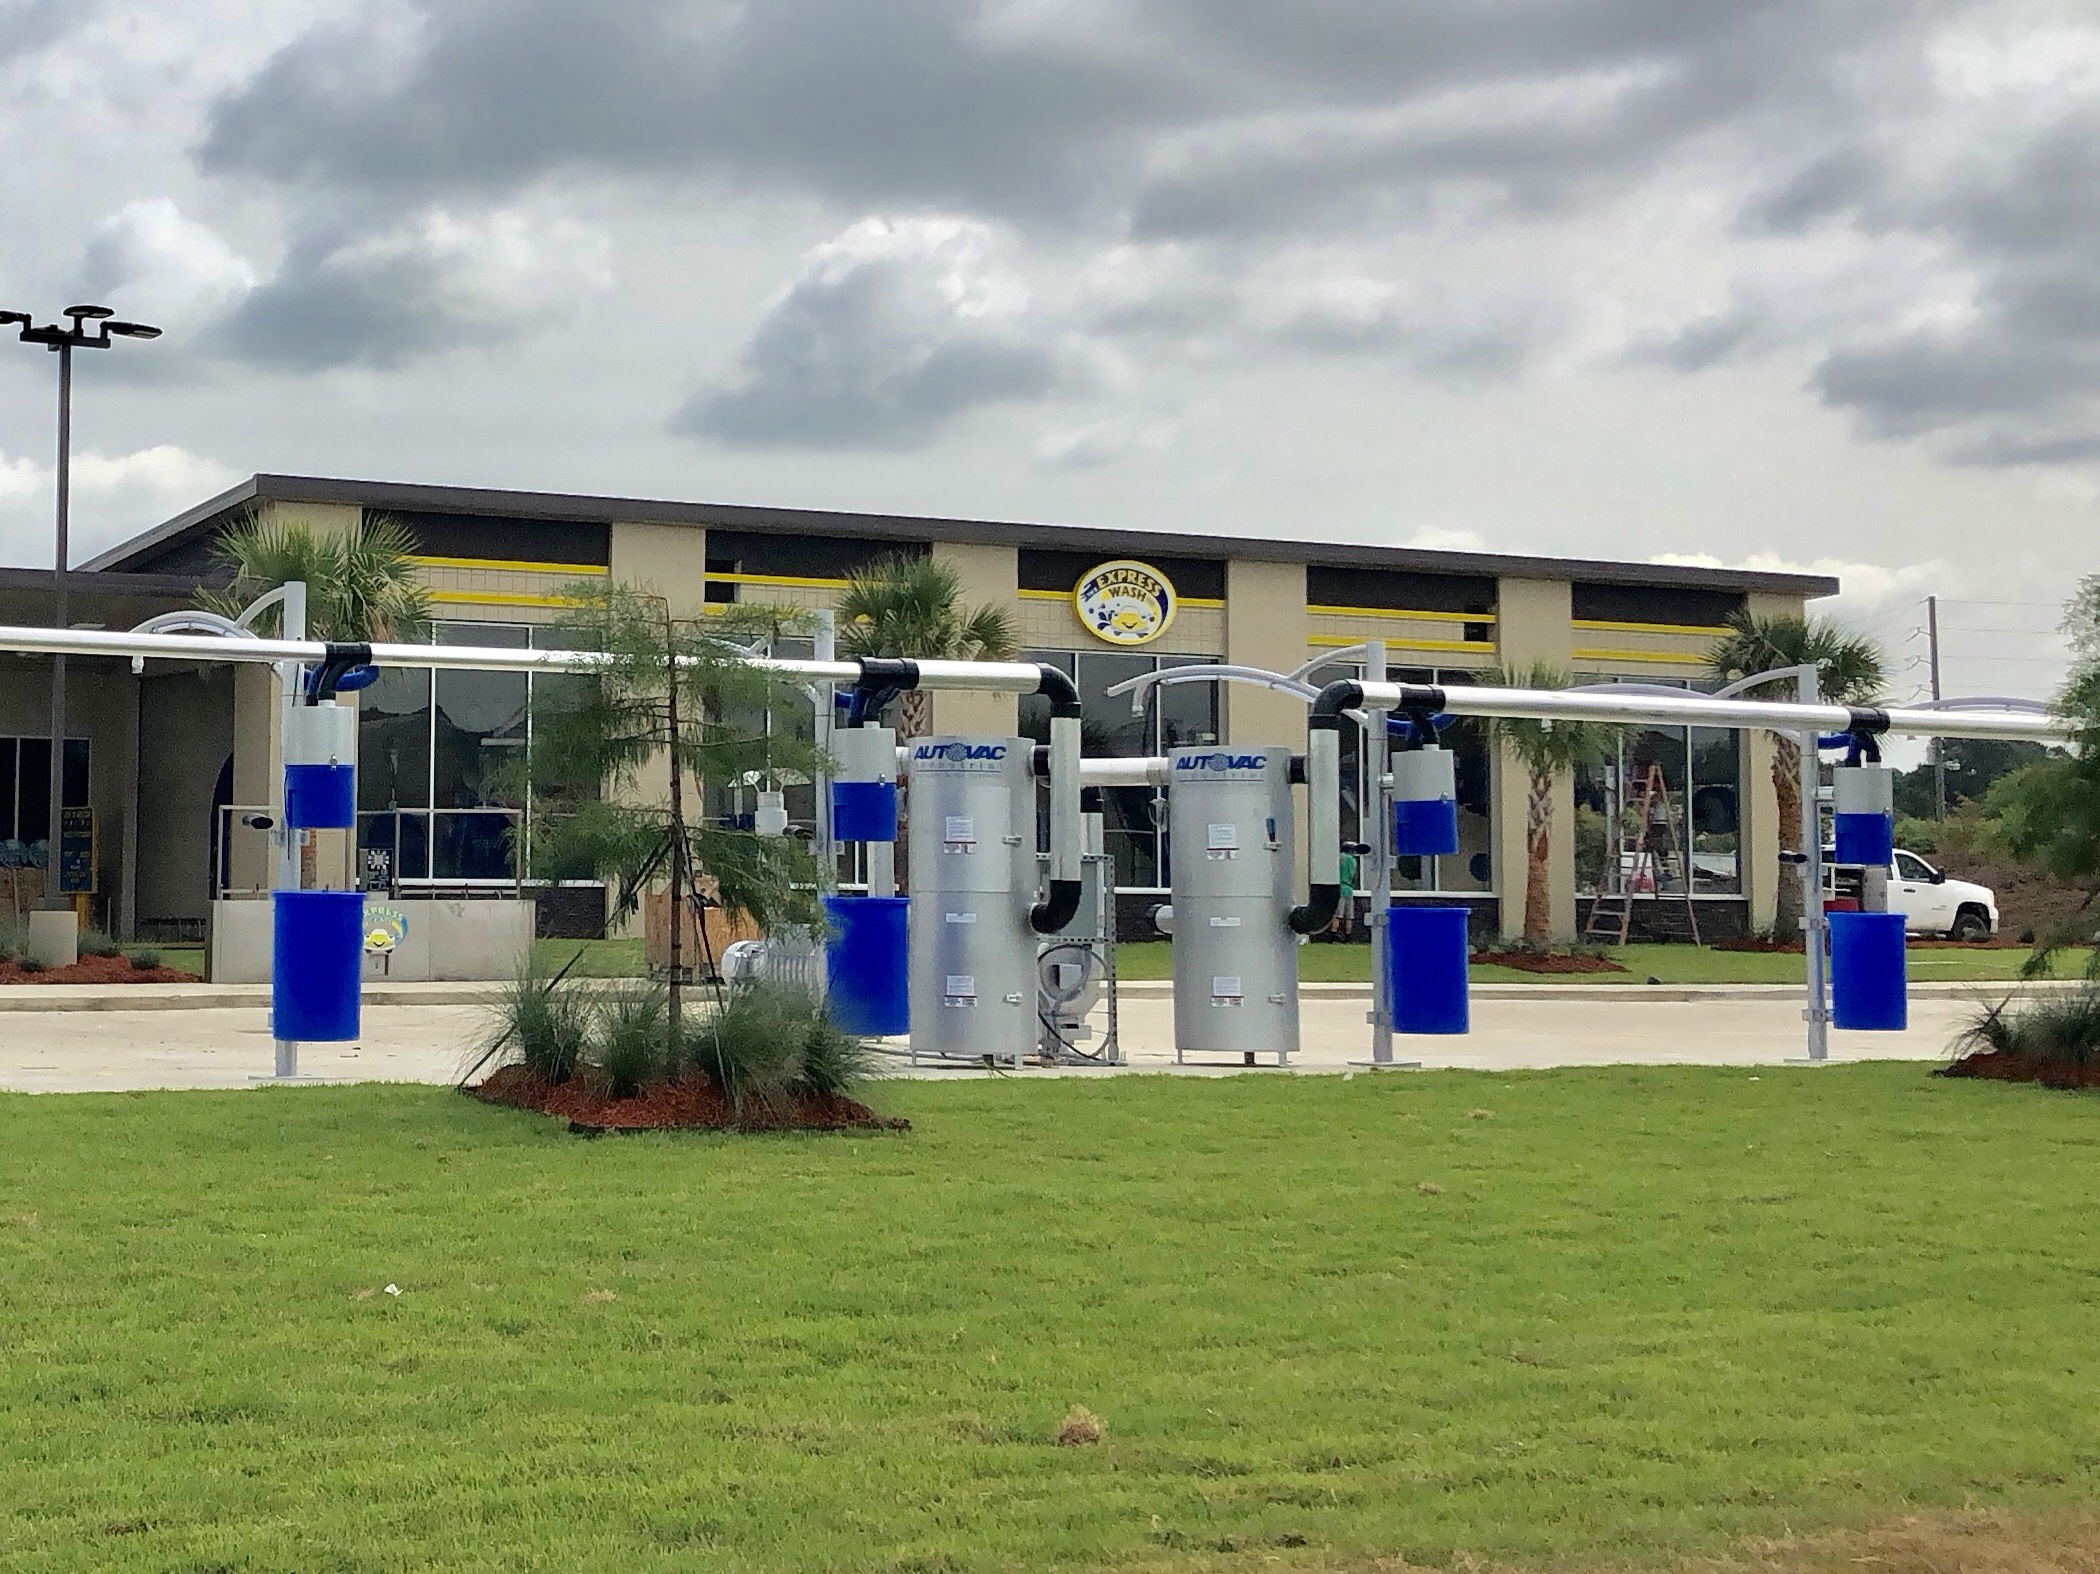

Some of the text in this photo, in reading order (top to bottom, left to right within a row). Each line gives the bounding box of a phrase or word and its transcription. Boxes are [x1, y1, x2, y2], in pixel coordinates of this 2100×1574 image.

[1096, 569, 1161, 597] EXPRESS
[1108, 586, 1147, 602] WASH
[914, 743, 1007, 762] AUTOVAC
[1176, 753, 1267, 771] AUTOVAC
